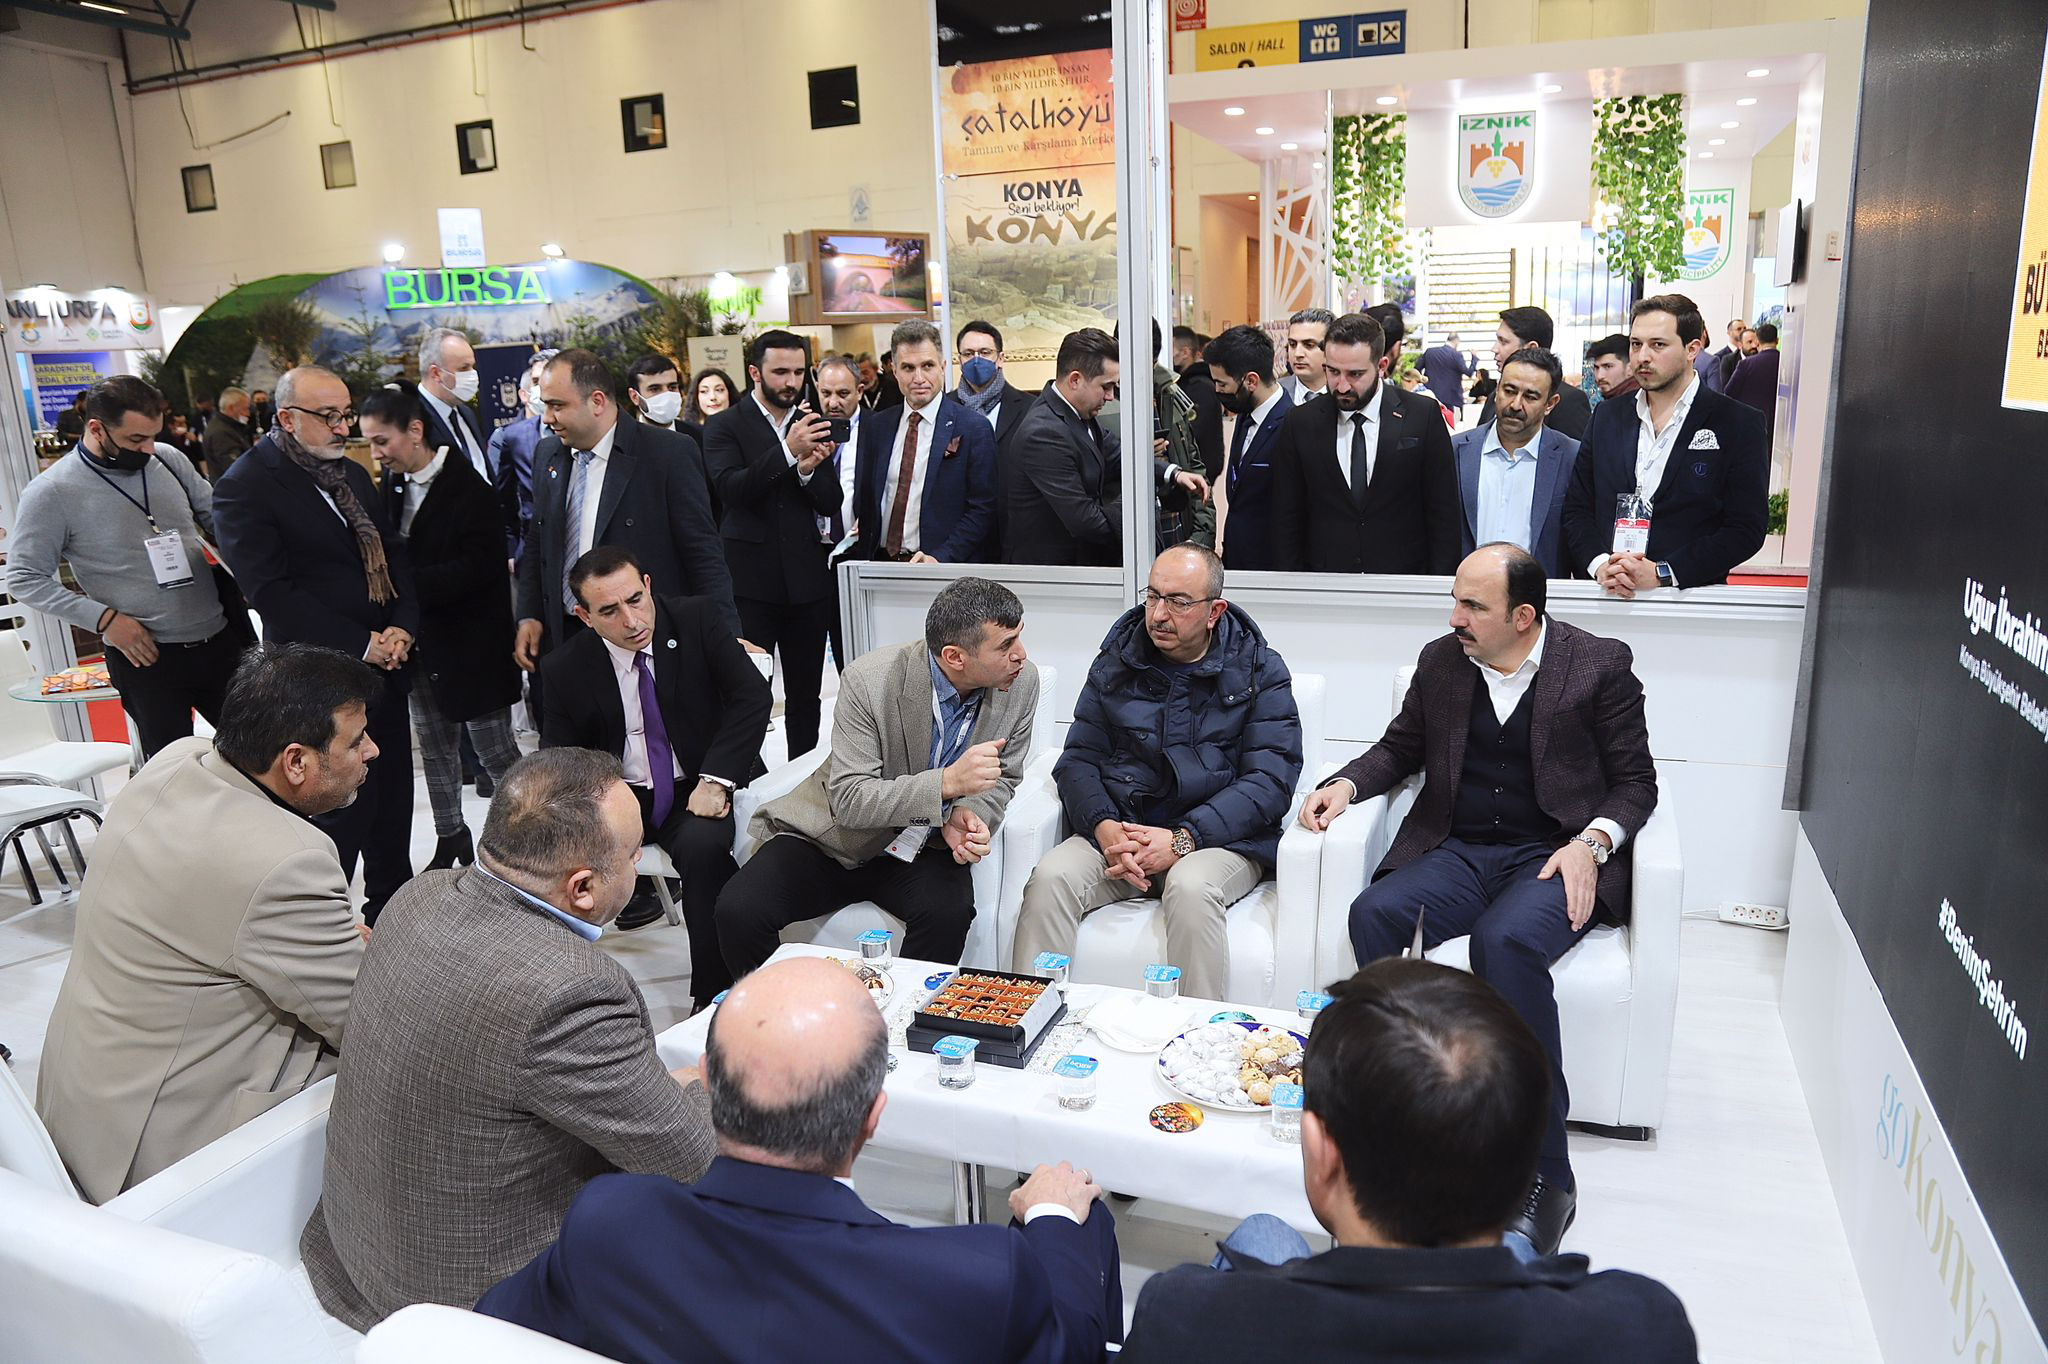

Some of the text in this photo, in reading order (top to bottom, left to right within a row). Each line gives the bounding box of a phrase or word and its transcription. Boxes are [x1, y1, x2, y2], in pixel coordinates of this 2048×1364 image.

[1313, 23, 1338, 37] WC
[1209, 41, 1246, 56] SALON
[1257, 38, 1285, 51] HALL
[991, 73, 1001, 83] 10
[992, 83, 1002, 94] 10
[1004, 178, 1083, 202] KONYA
[384, 265, 545, 308] BURSA
[1964, 577, 1996, 635] Uğur
[1959, 644, 1980, 680] Konya
[1938, 897, 2027, 1060] #BenimŞehrim
